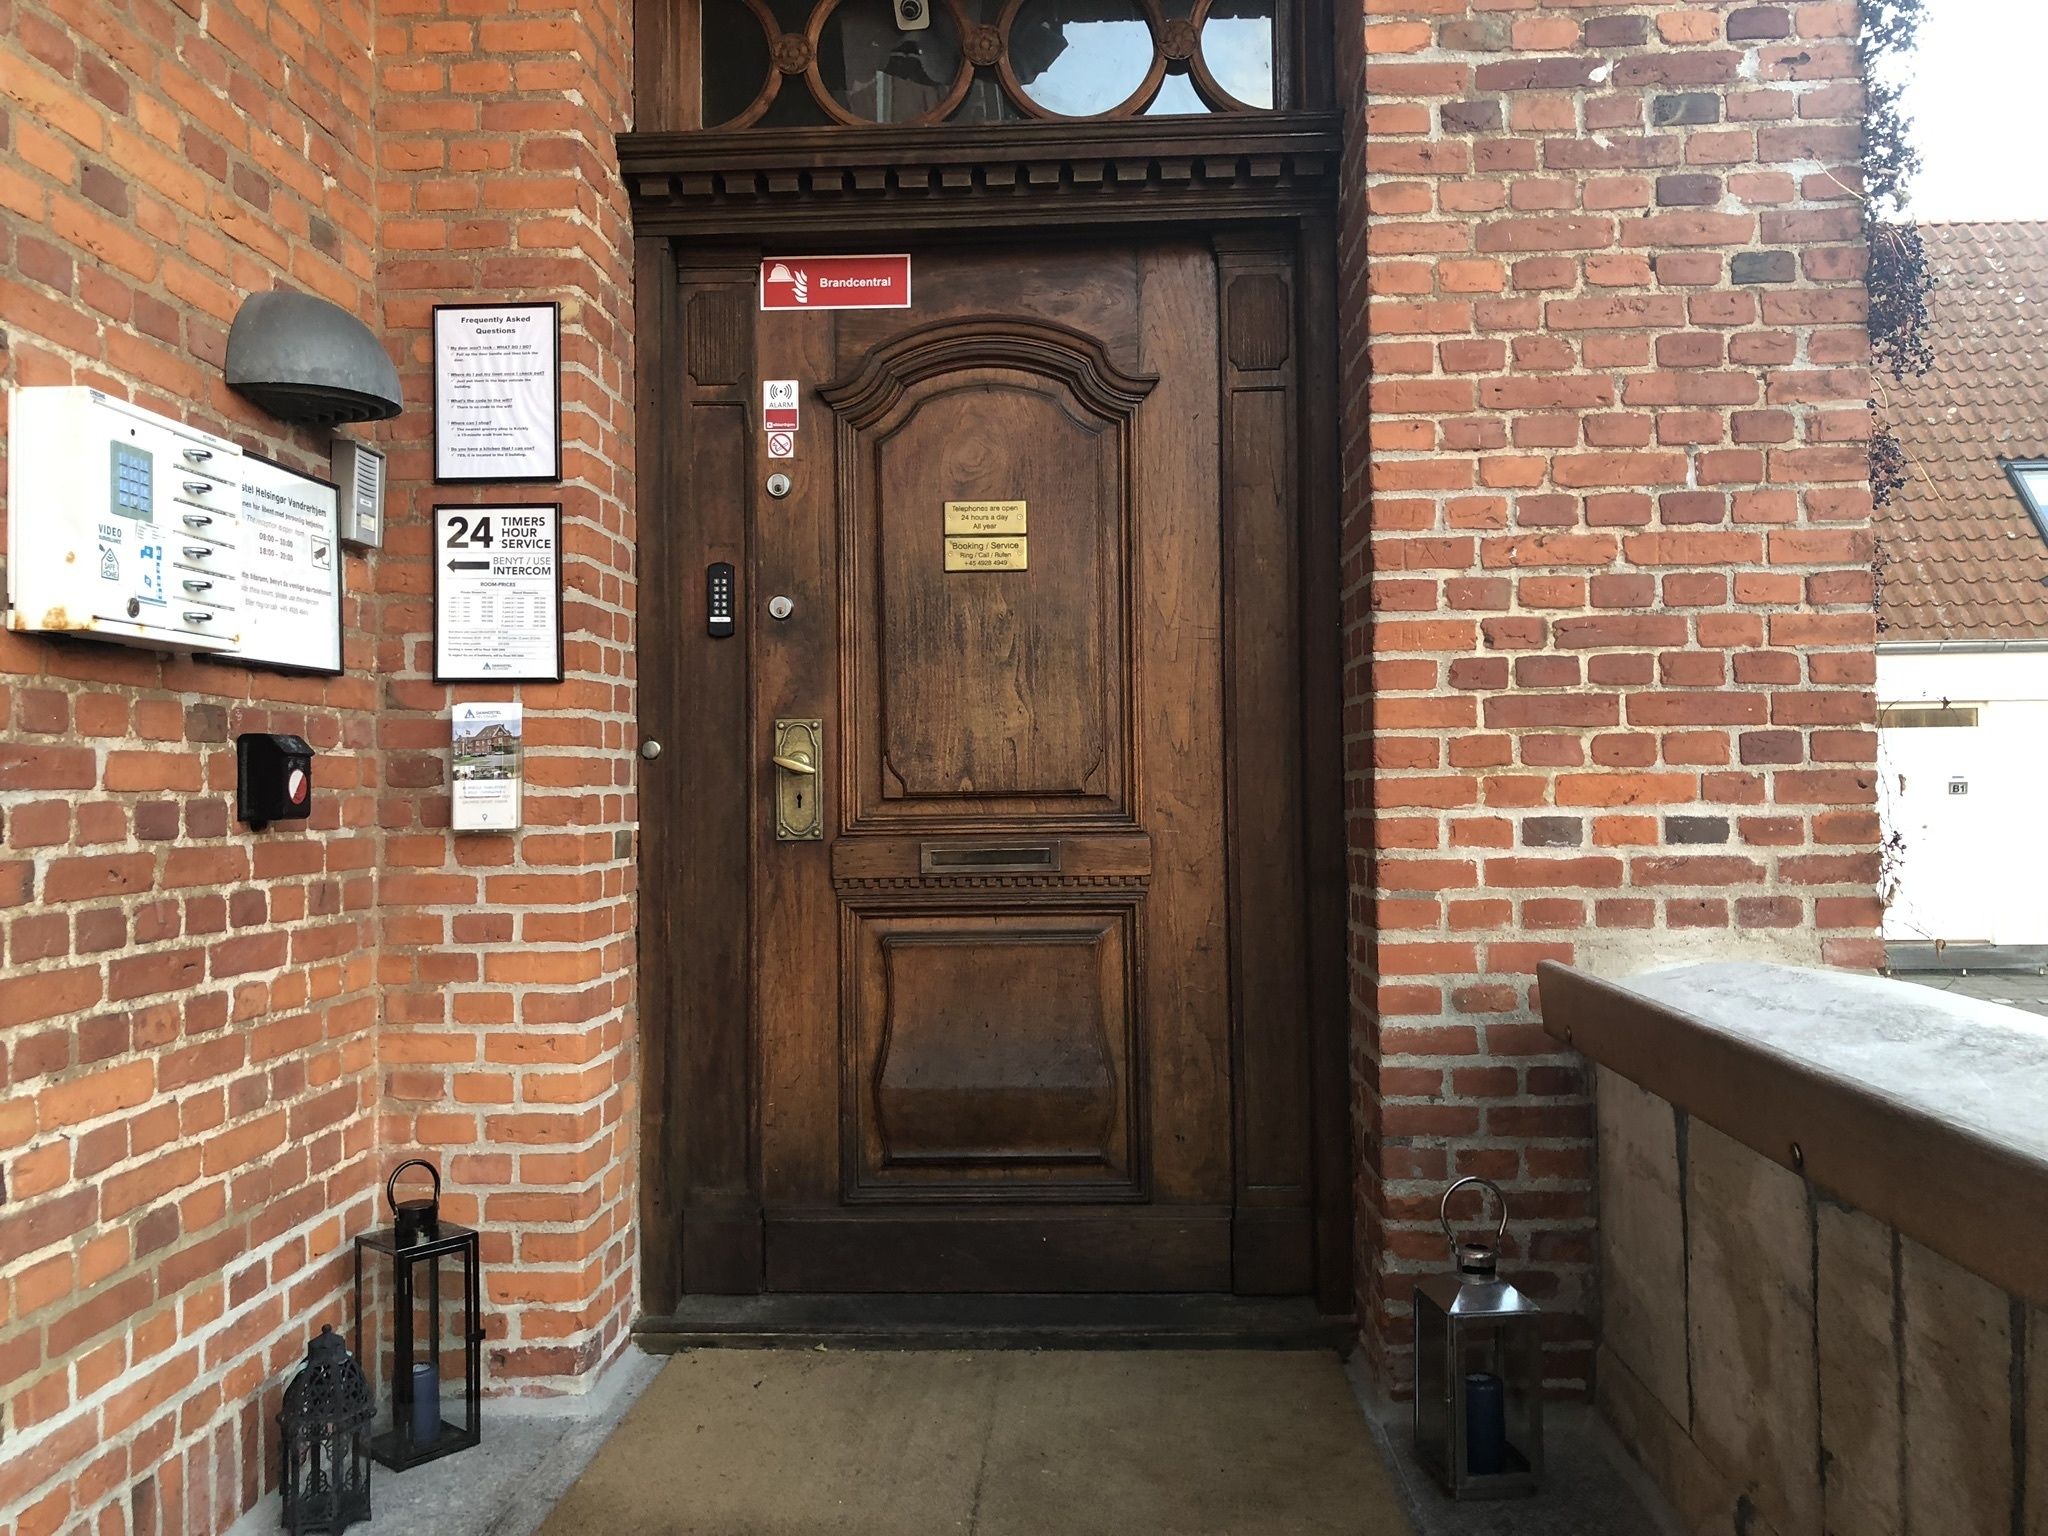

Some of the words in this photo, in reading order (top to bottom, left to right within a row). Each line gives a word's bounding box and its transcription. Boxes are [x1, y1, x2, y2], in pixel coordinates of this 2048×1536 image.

[820, 277, 891, 288] Brandcentral
[256, 486, 286, 504] Helsingør
[288, 497, 326, 517] Vandrerhjem
[98, 524, 122, 537] VIDEO
[447, 516, 493, 548] 24
[501, 517, 545, 526] TIMERS
[502, 528, 537, 538] HOUR
[501, 539, 551, 549] SERVICE
[952, 543, 984, 551] Booking
[493, 557, 524, 565] BENYT
[526, 557, 531, 565] /
[533, 557, 551, 565] USE
[493, 567, 551, 575] INTERCOM
